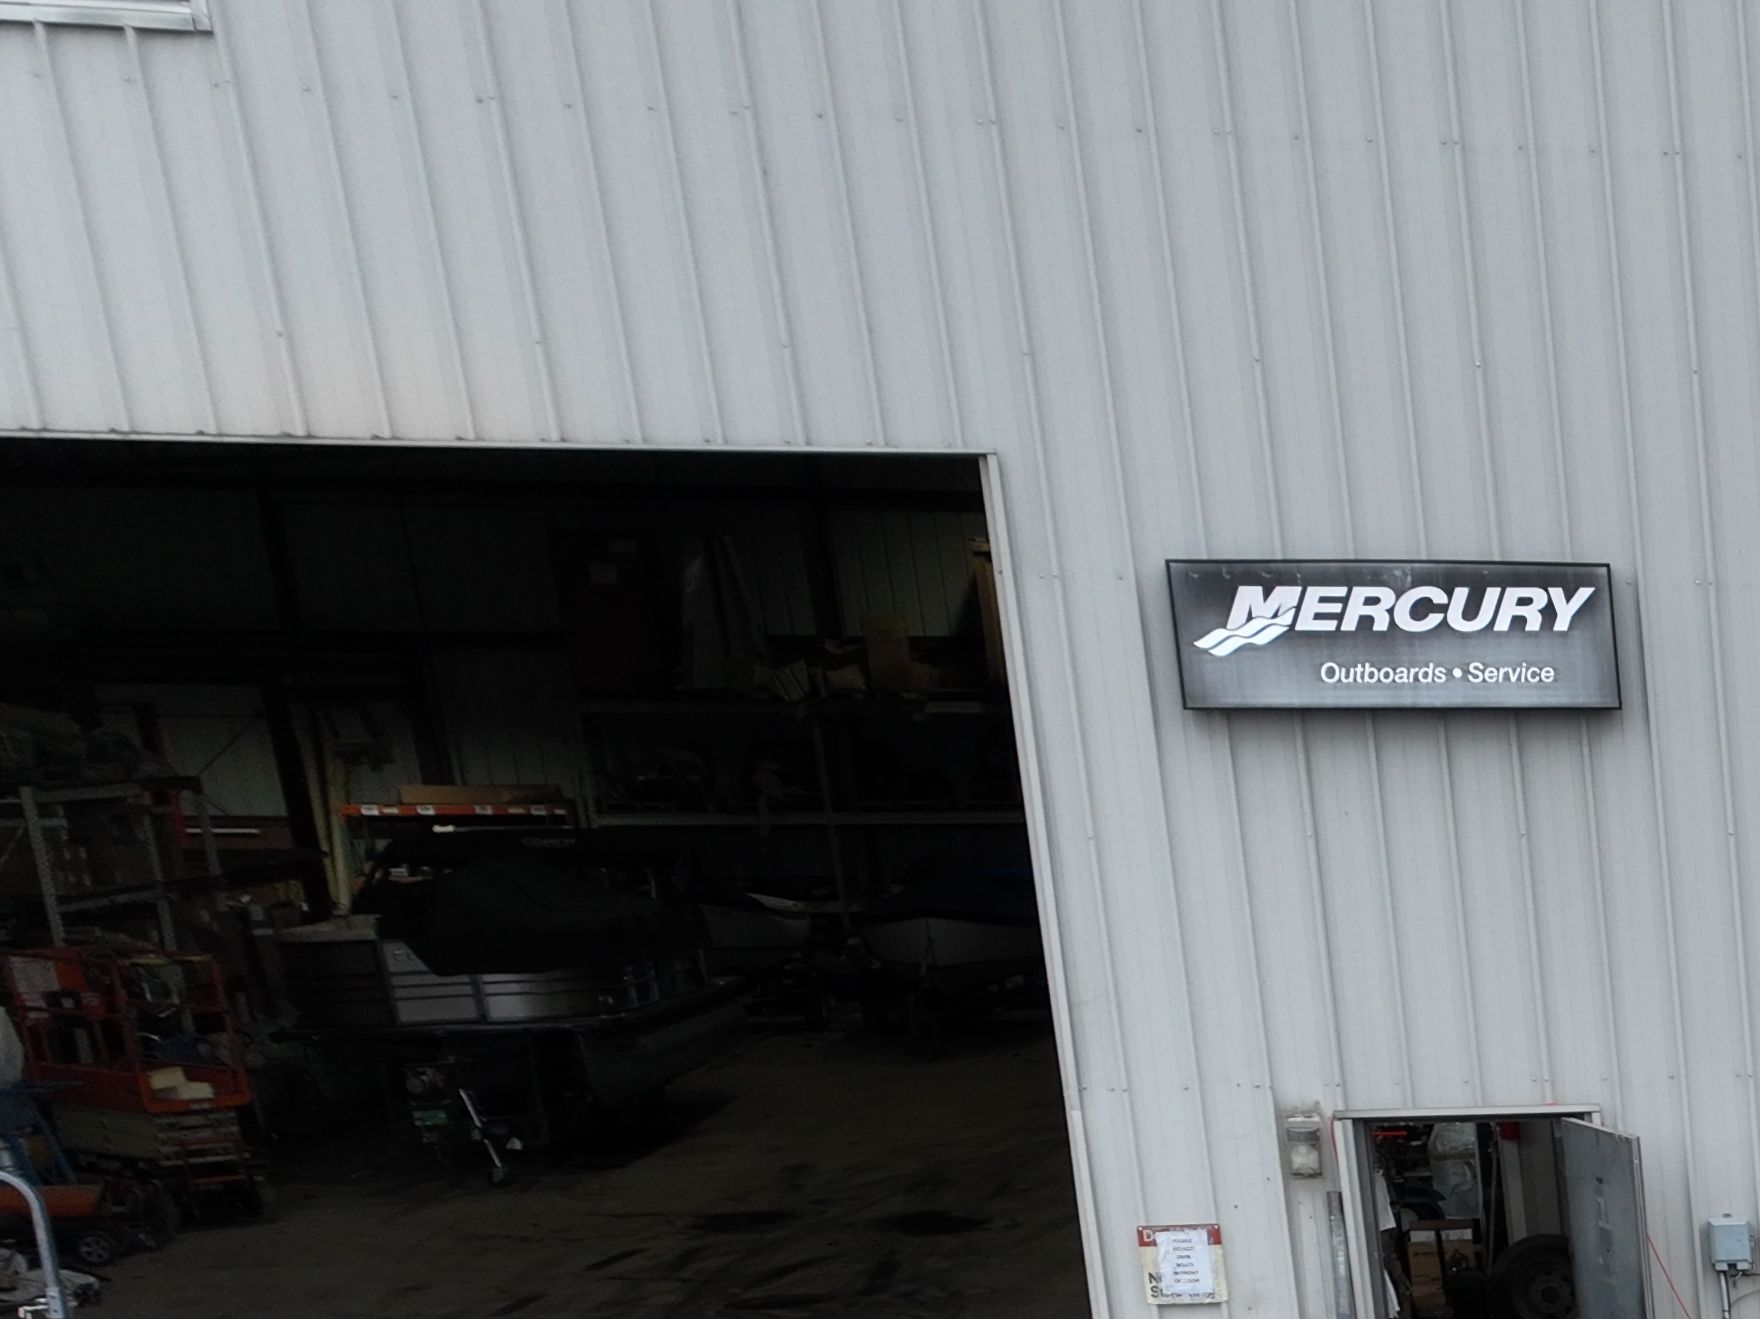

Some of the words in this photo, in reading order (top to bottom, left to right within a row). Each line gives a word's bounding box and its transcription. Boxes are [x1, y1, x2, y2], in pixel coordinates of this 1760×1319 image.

[1224, 585, 1596, 634] MERCURY
[1320, 662, 1447, 684] Outboards
[1467, 662, 1555, 684] Service
